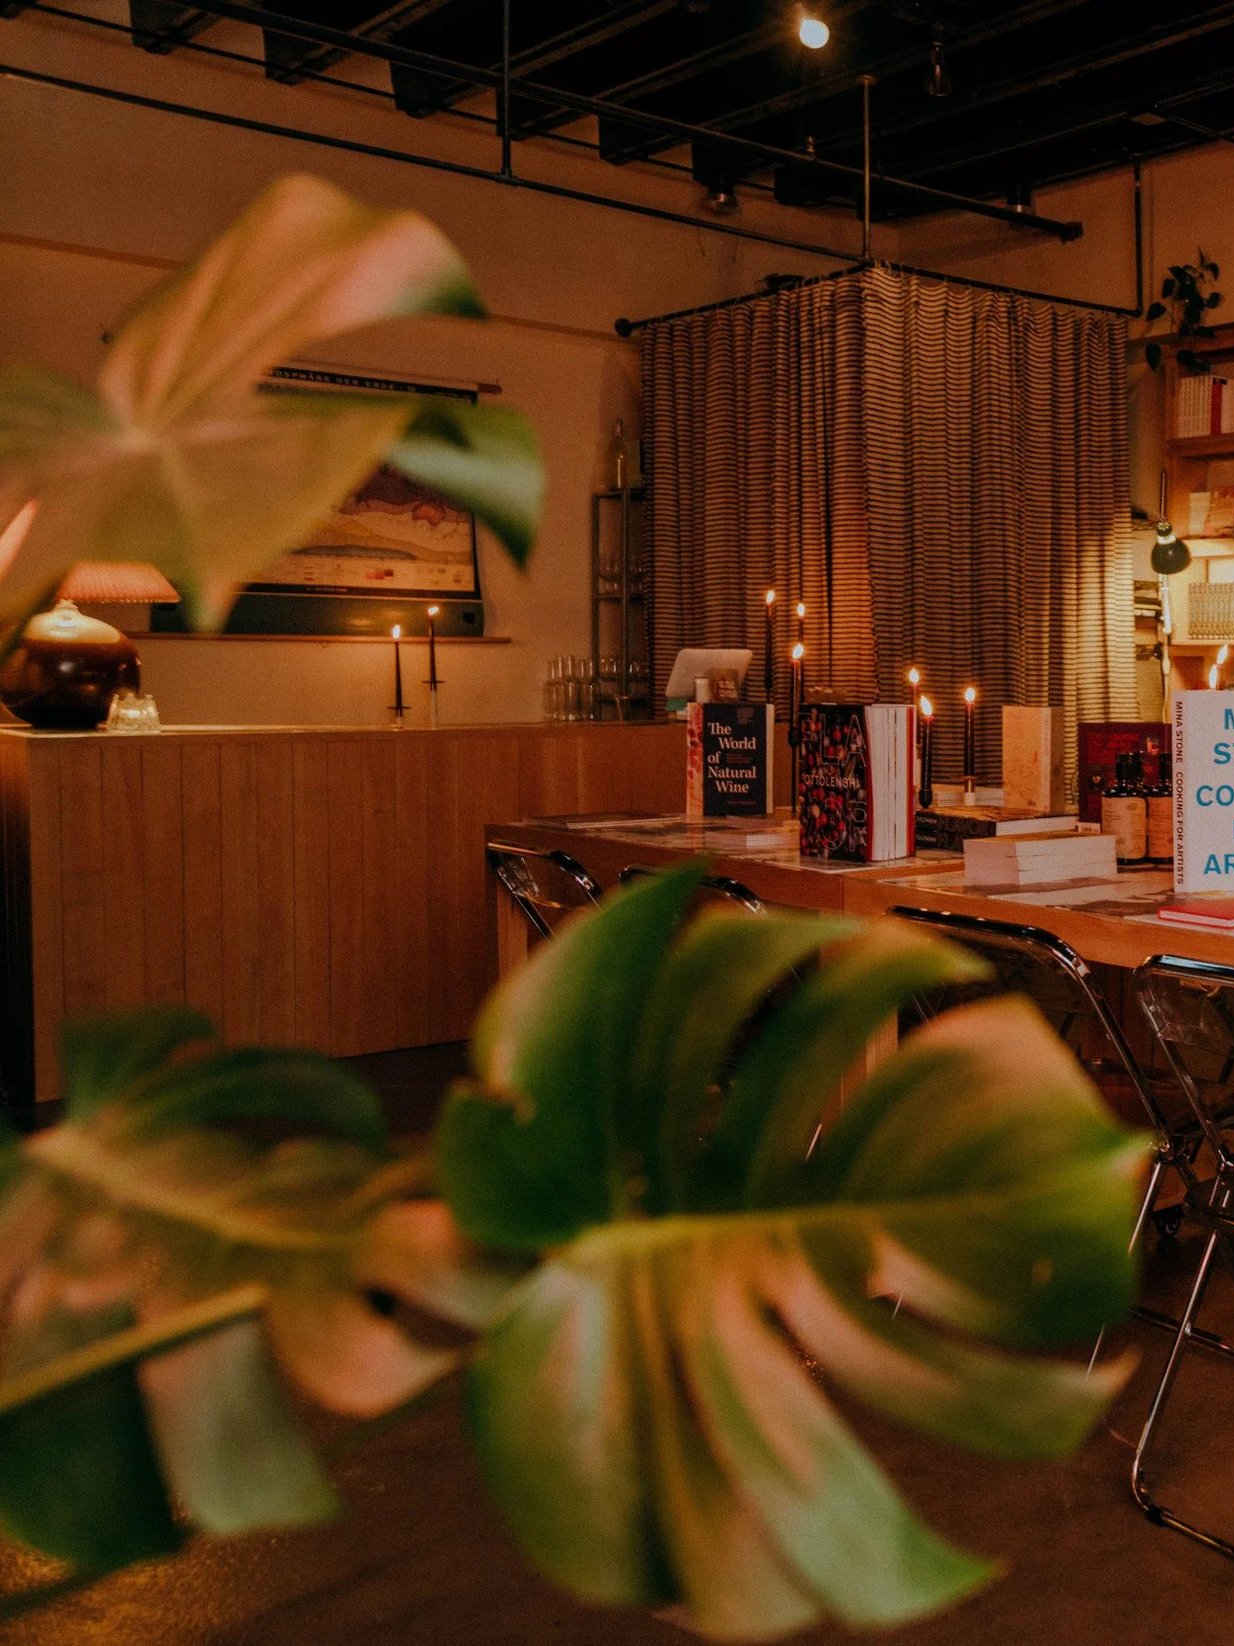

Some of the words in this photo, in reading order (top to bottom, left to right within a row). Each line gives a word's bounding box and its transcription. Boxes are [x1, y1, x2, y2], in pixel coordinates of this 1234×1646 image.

[1175, 701, 1183, 728] MINA
[707, 722, 732, 735] The
[718, 737, 757, 750] World
[1175, 730, 1183, 764] STONE
[707, 751, 721, 764] of
[707, 765, 757, 779] Natural
[715, 780, 750, 793] Wine
[1175, 771, 1184, 818] COOKING
[1176, 820, 1184, 840] FOR
[1176, 842, 1184, 885] ARTISTS
